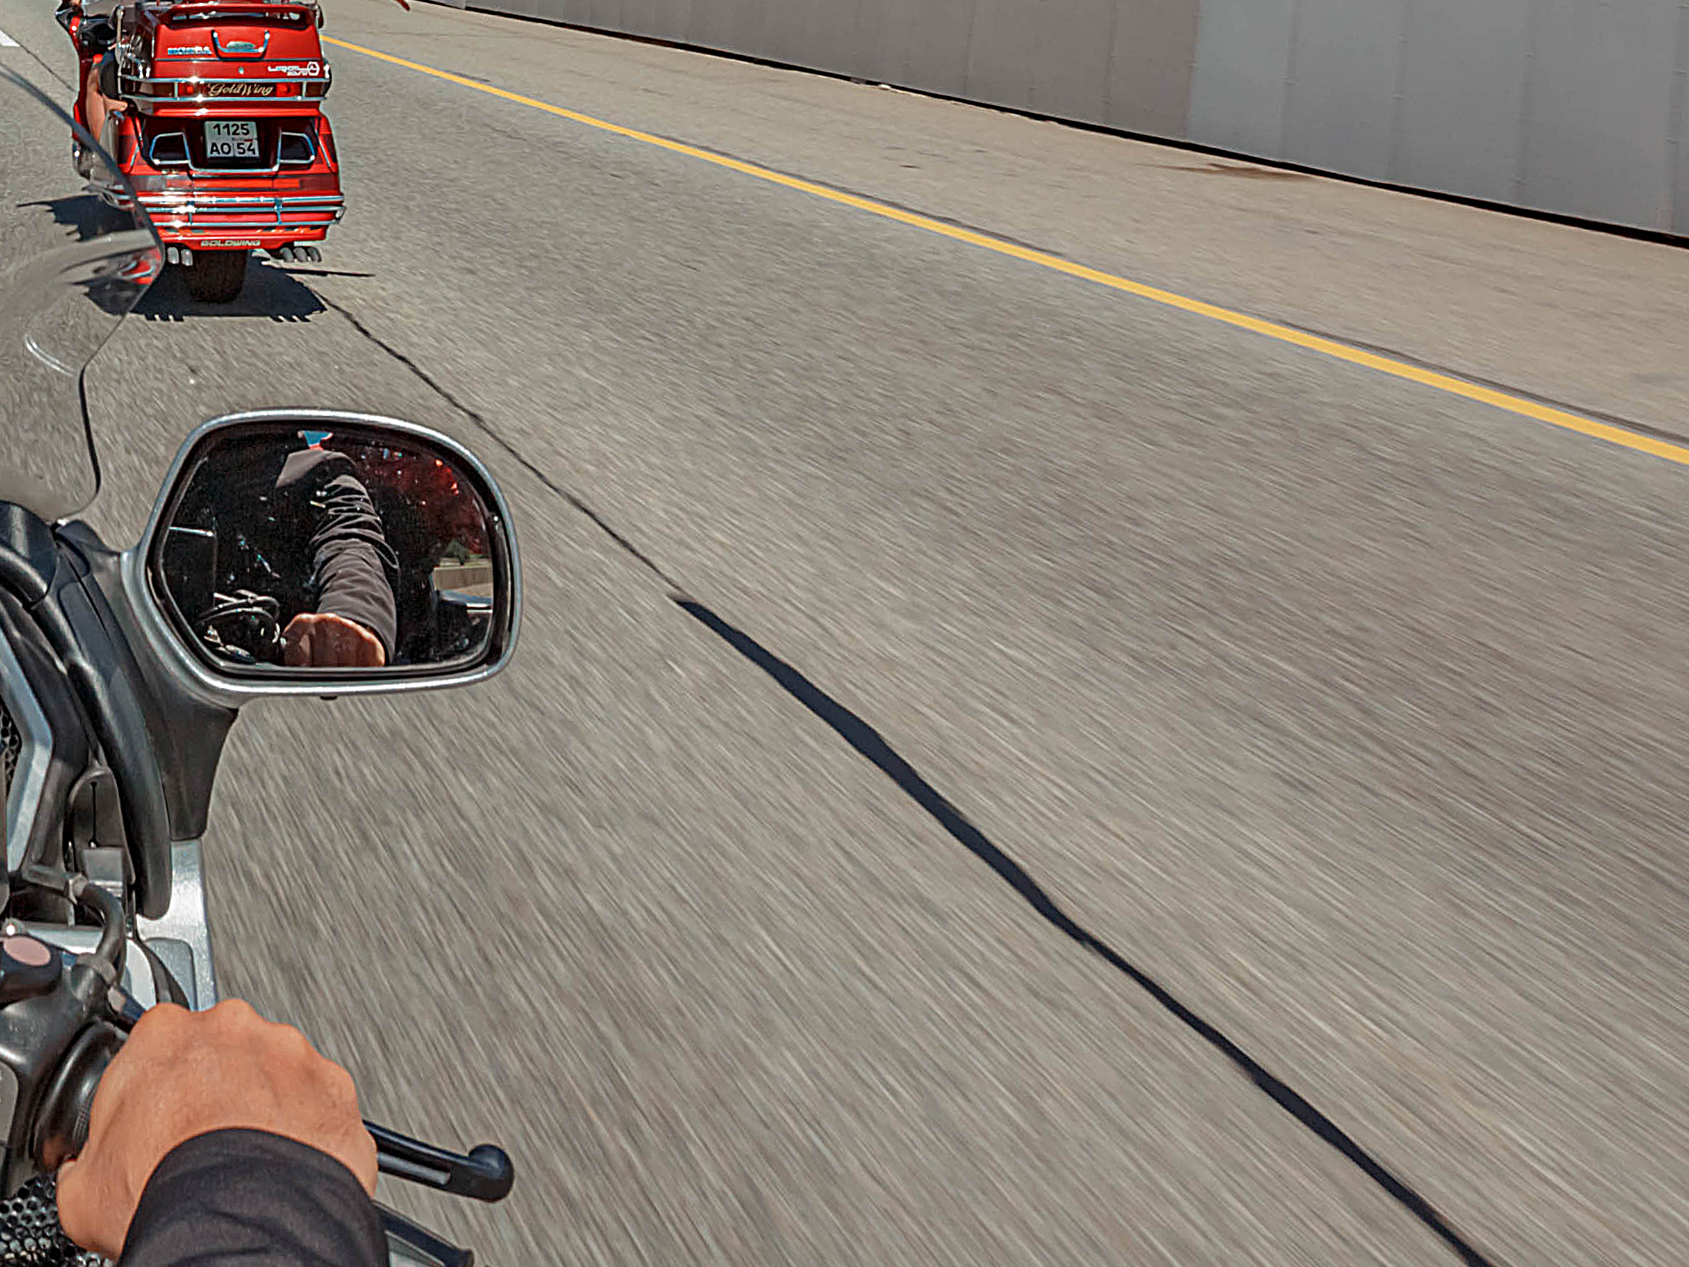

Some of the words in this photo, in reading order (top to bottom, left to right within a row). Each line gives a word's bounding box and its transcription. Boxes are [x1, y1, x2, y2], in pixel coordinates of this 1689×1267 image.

[212, 123, 250, 136] 1125
[210, 142, 232, 155] AO
[236, 142, 256, 155] 54
